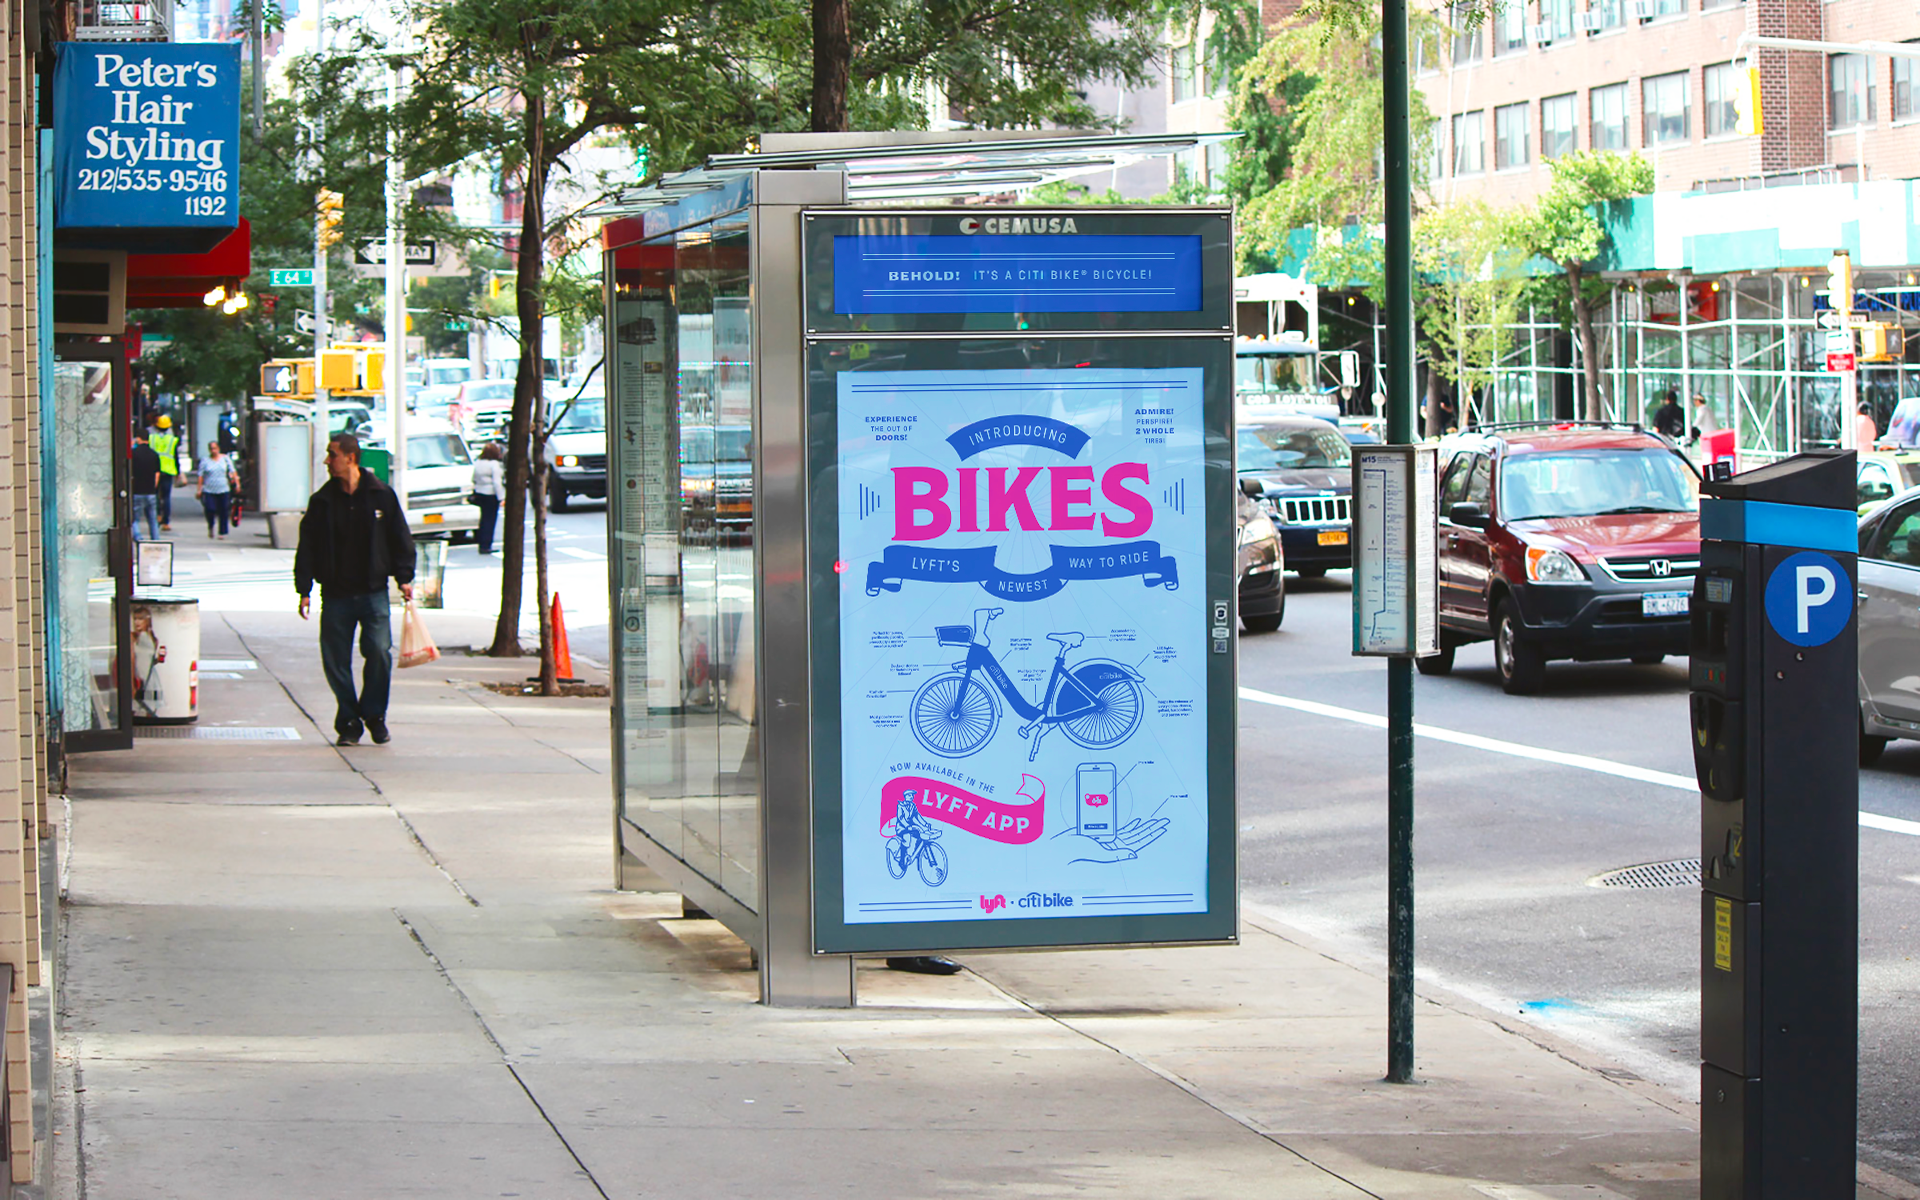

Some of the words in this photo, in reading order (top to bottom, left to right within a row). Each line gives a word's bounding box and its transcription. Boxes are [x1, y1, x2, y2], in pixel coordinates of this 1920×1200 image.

[95, 54, 217, 87] Peter's
[111, 90, 193, 125] Hair
[86, 126, 225, 170] Styling
[185, 196, 226, 216] 1192
[984, 217, 1078, 234] CEMUSA
[274, 271, 280, 284] E
[285, 271, 299, 284] 64
[888, 270, 960, 281] BEHOLD!
[974, 269, 999, 281] IT'S
[1004, 270, 1013, 280] A
[1018, 269, 1044, 281] CITI
[1093, 269, 1152, 280] BICYCLE!
[865, 415, 918, 423] EXPERIENCE
[968, 424, 1068, 446] INTRODUCING
[1361, 455, 1377, 464] M15
[890, 461, 1154, 541] BIKES
[912, 557, 960, 572] LYFT'S
[1068, 558, 1093, 568] WAY
[1099, 556, 1114, 567] TO
[1119, 551, 1150, 565] RIDE
[998, 579, 1048, 593] NEWEST
[1796, 565, 1836, 634] P
[889, 762, 911, 774] NOW
[914, 762, 964, 782] AVAILABLE
[965, 776, 976, 787] IN
[979, 781, 995, 795] THE
[921, 788, 979, 820] LYFT
[981, 811, 1030, 834] APP
